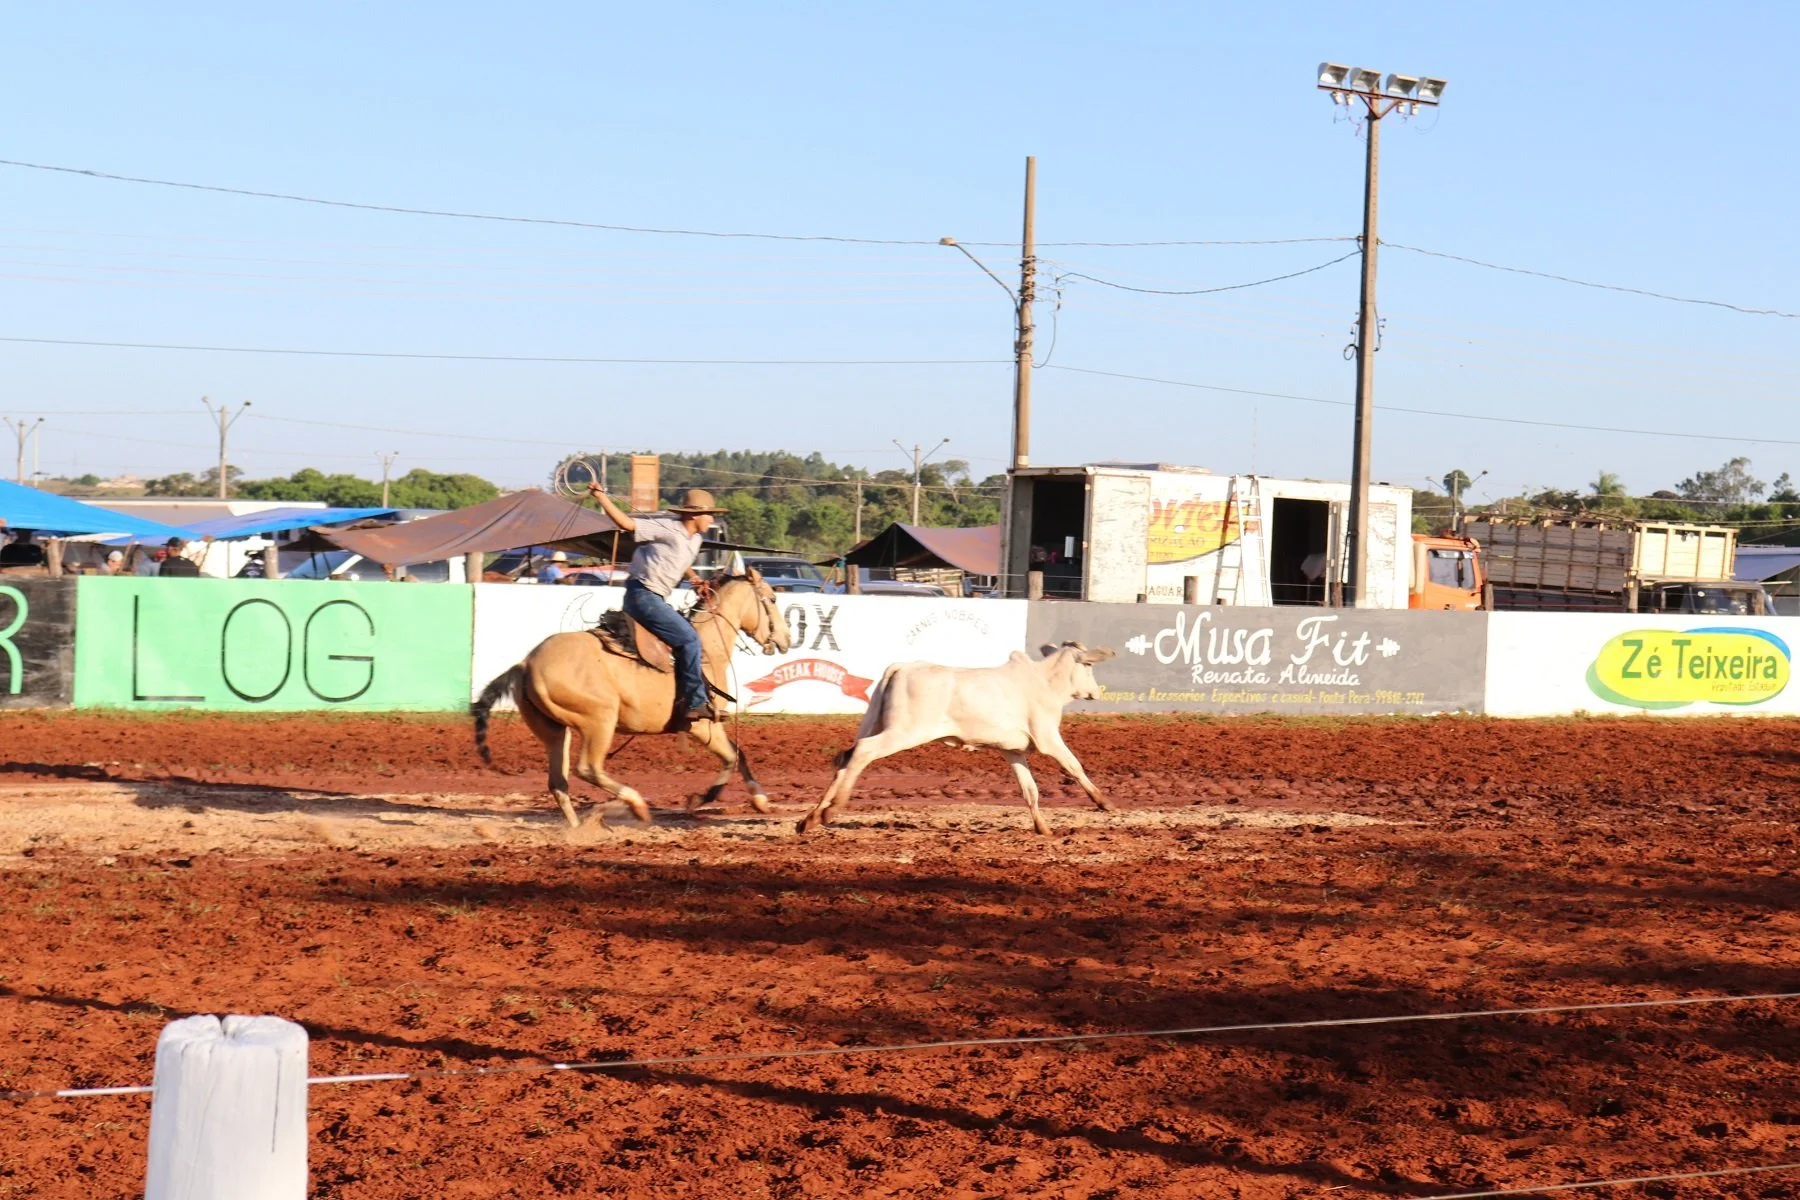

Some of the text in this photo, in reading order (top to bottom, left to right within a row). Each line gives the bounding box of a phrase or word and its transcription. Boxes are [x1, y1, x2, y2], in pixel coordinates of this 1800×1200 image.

[132, 594, 375, 702] LOG
[1154, 610, 1371, 666] Musa Fit
[773, 662, 811, 684] STEAK
[1191, 664, 1361, 686] Renata Almeida
[1621, 639, 1777, 679] Zé Teixeira
